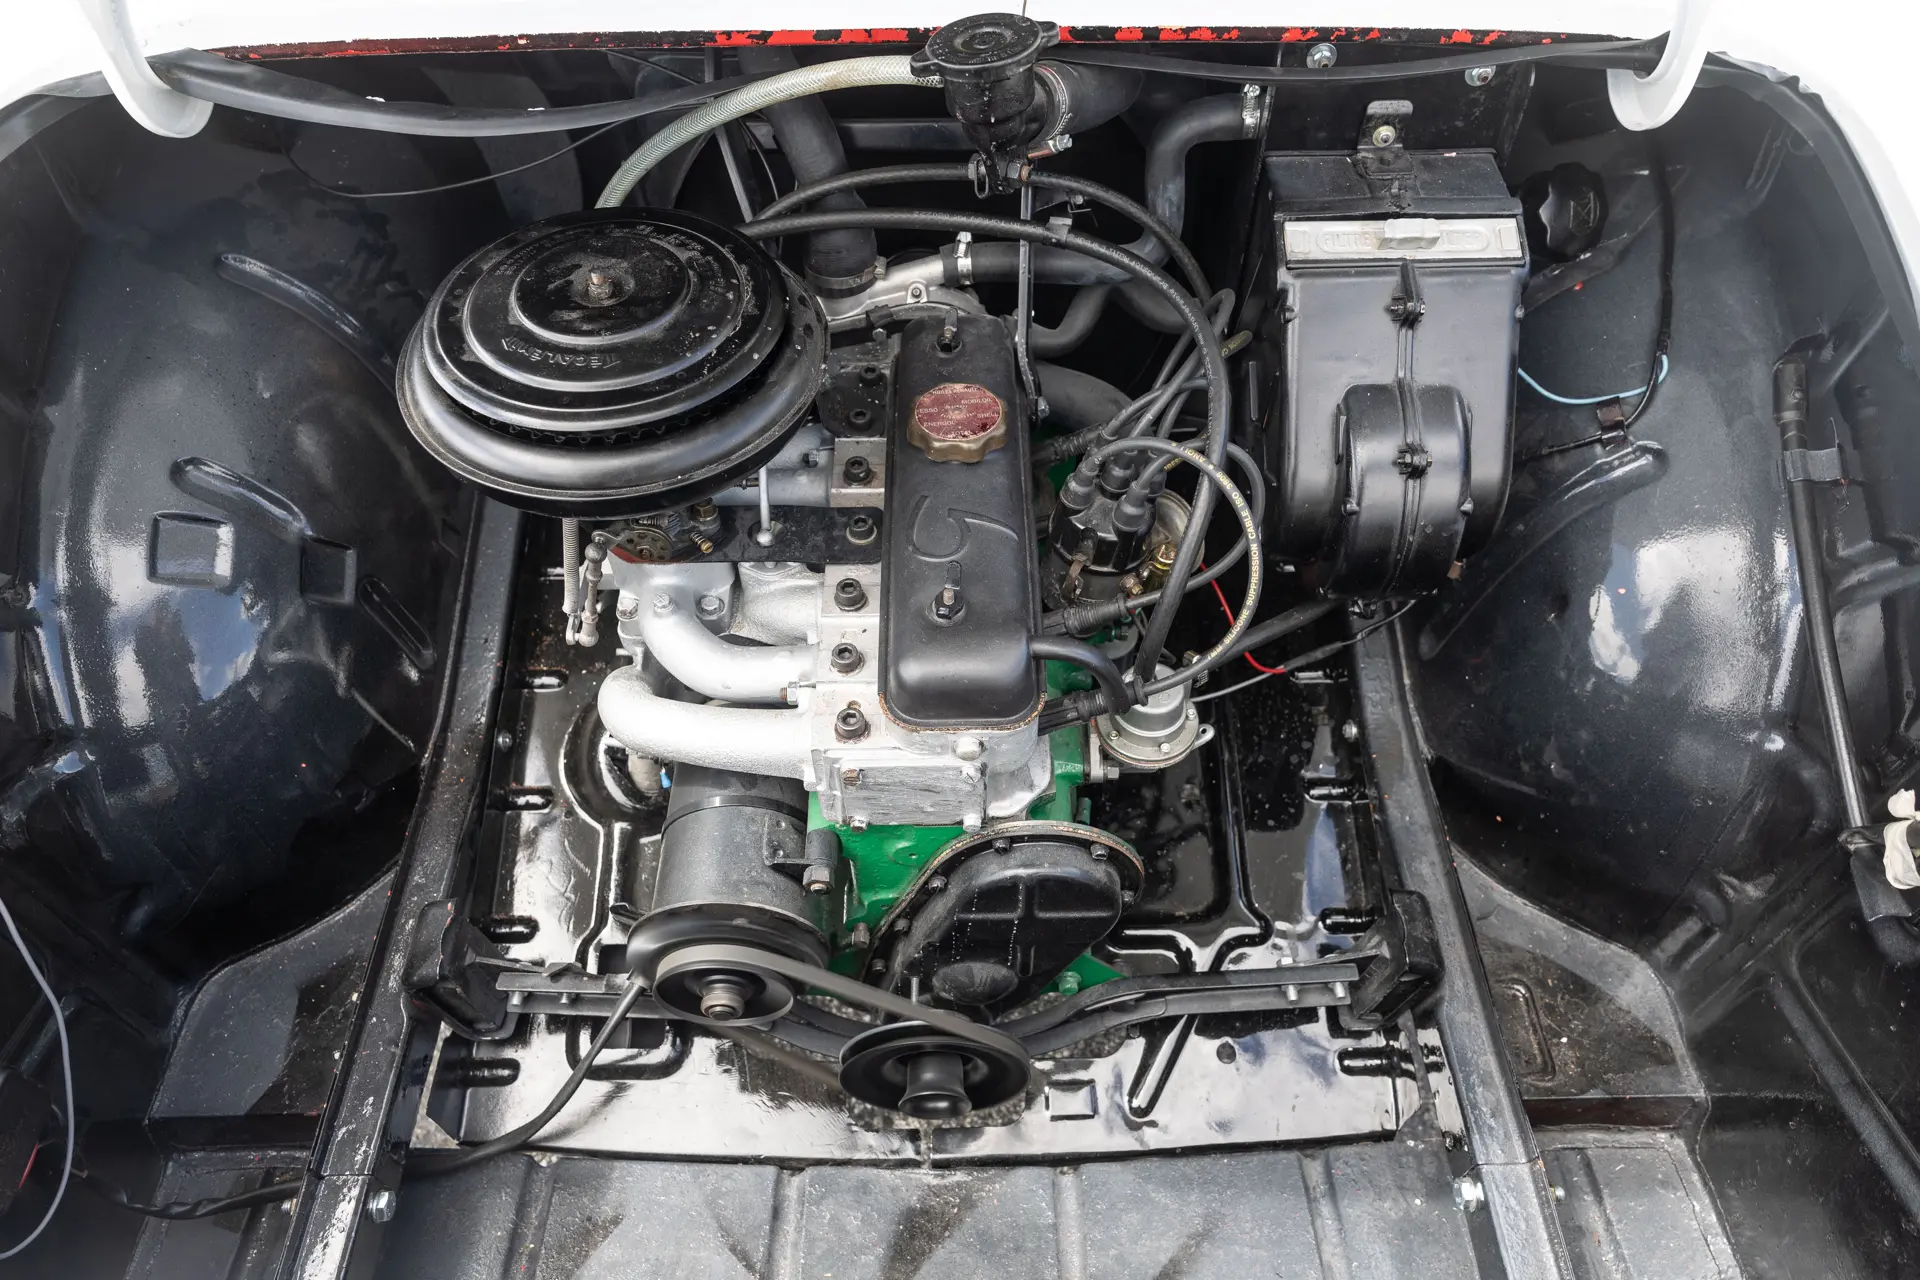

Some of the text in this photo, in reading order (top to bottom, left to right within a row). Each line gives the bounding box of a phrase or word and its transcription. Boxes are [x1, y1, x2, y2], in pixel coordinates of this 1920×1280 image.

[952, 386, 978, 395] RENAULT
[977, 411, 1000, 419] SHELL
[1231, 490, 1245, 508] ISO
[1240, 508, 1256, 540] CABLE
[1246, 543, 1260, 606] SUPPRESSION
[1223, 608, 1250, 644] SILICONE
